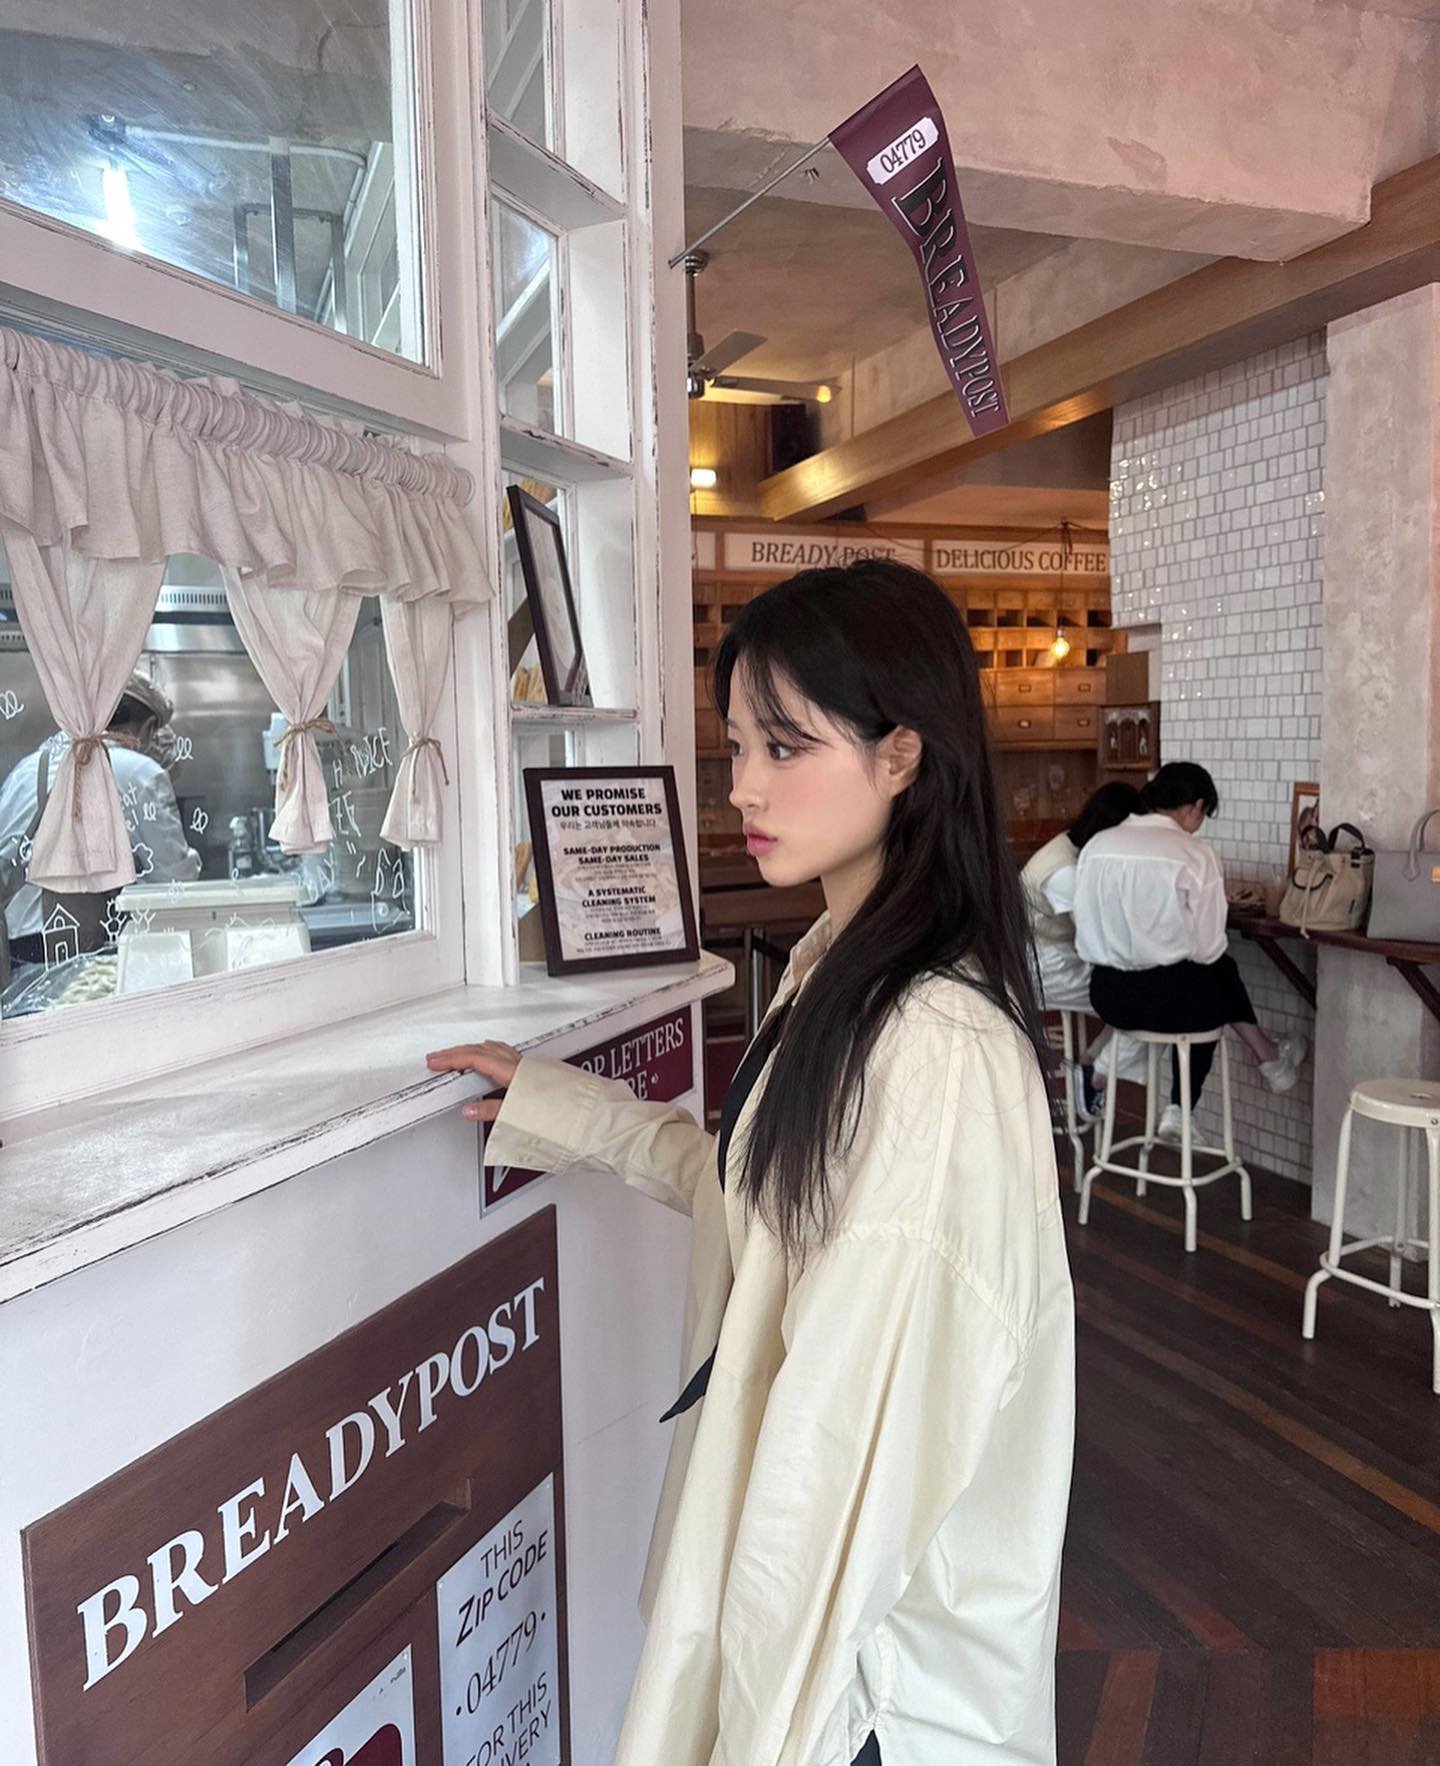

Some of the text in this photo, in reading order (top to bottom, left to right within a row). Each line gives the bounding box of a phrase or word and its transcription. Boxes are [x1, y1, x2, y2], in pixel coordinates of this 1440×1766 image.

[880, 129, 926, 174] 04779
[892, 157, 1001, 417] BREADYPOST
[752, 541, 838, 565] BREADY
[936, 549, 1107, 572] DELICIOUS COFFEE
[561, 788, 646, 800] WE PROMISE
[551, 803, 662, 817] OUR CUSTOMERS
[563, 844, 661, 855] SAME-DAY PRODUCTION
[578, 854, 649, 864] SAME-DAY SALES
[582, 896, 656, 908] CLEANING SYSTEM
[588, 886, 646, 897] A SYSTEMATIC
[584, 930, 625, 941] CLEANING
[627, 928, 661, 938] ROUTINE
[610, 1017, 684, 1078] LETTERS
[76, 1277, 544, 1691] BREADYPOST
[480, 1520, 524, 1578] THIS
[507, 1671, 547, 1733] THIS
